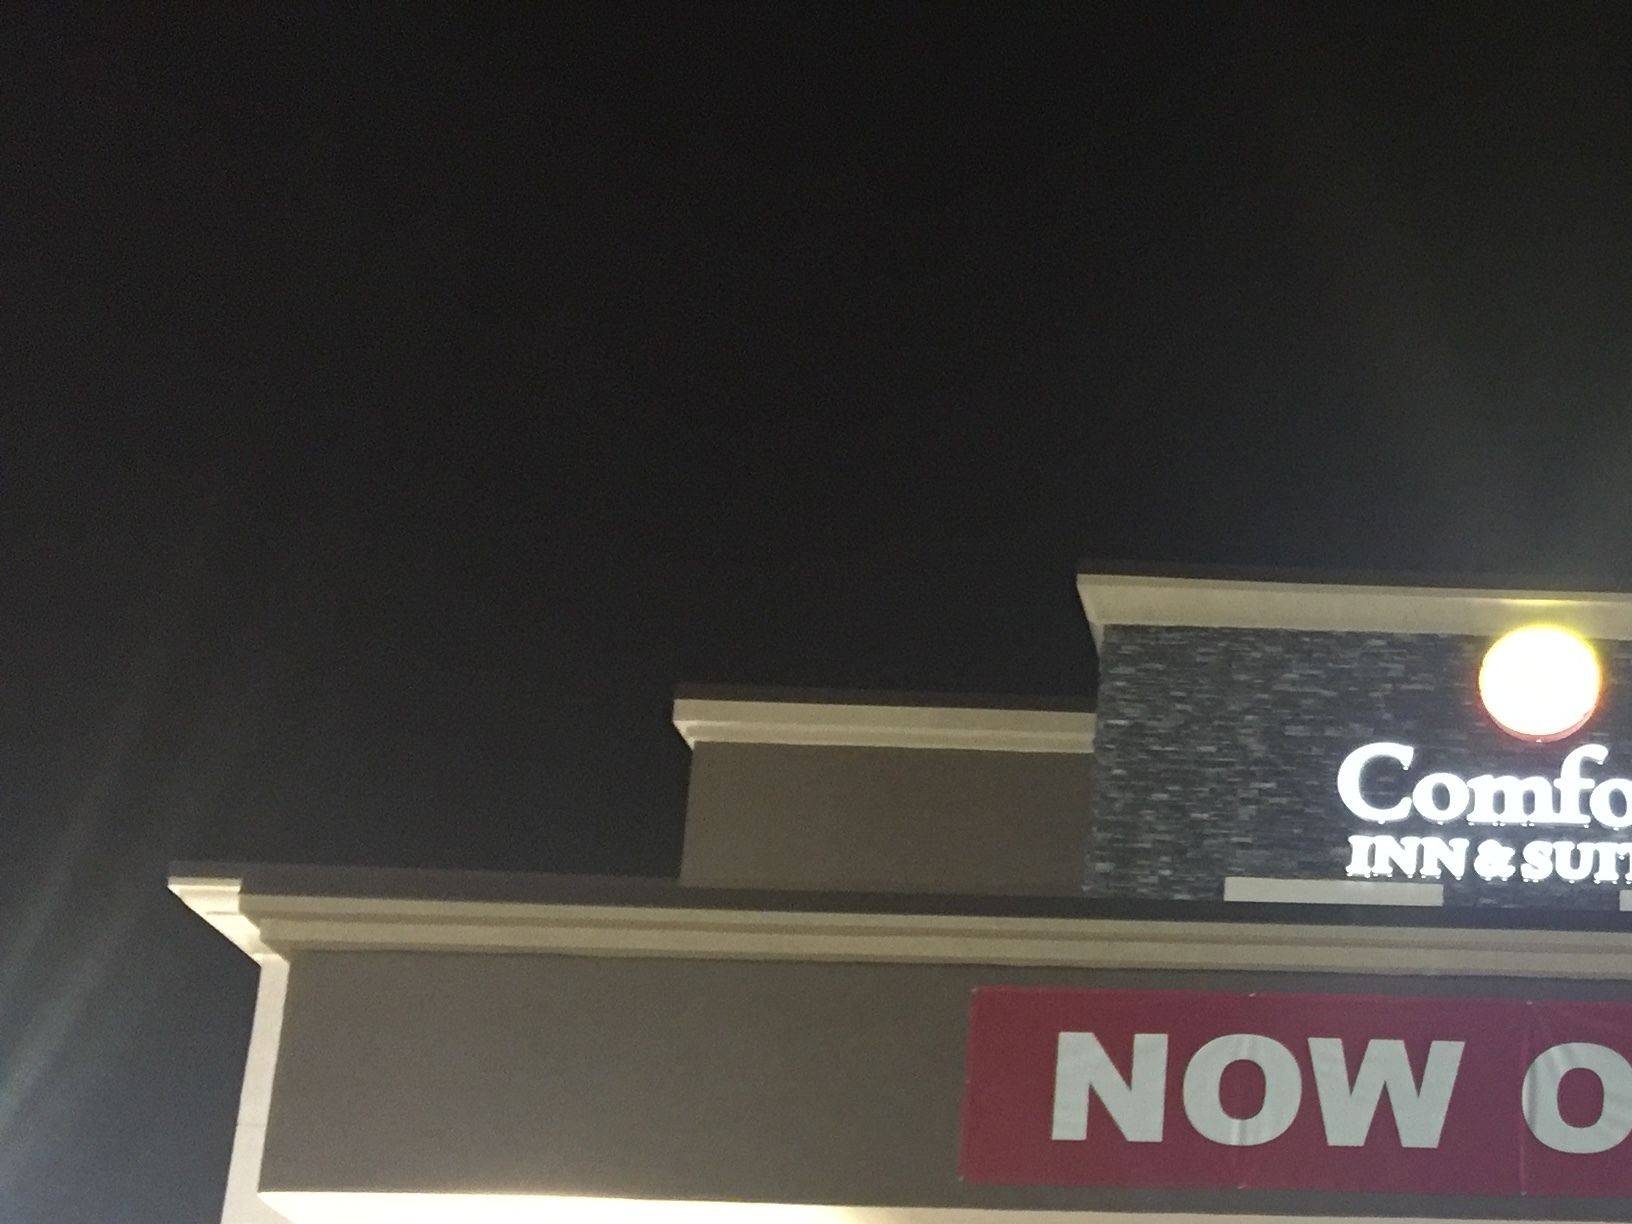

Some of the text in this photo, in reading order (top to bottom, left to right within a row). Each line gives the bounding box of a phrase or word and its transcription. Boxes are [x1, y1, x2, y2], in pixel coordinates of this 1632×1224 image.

[1346, 834, 1469, 879] INN
[1473, 838, 1516, 881] &
[1050, 1031, 1465, 1149] NOW
